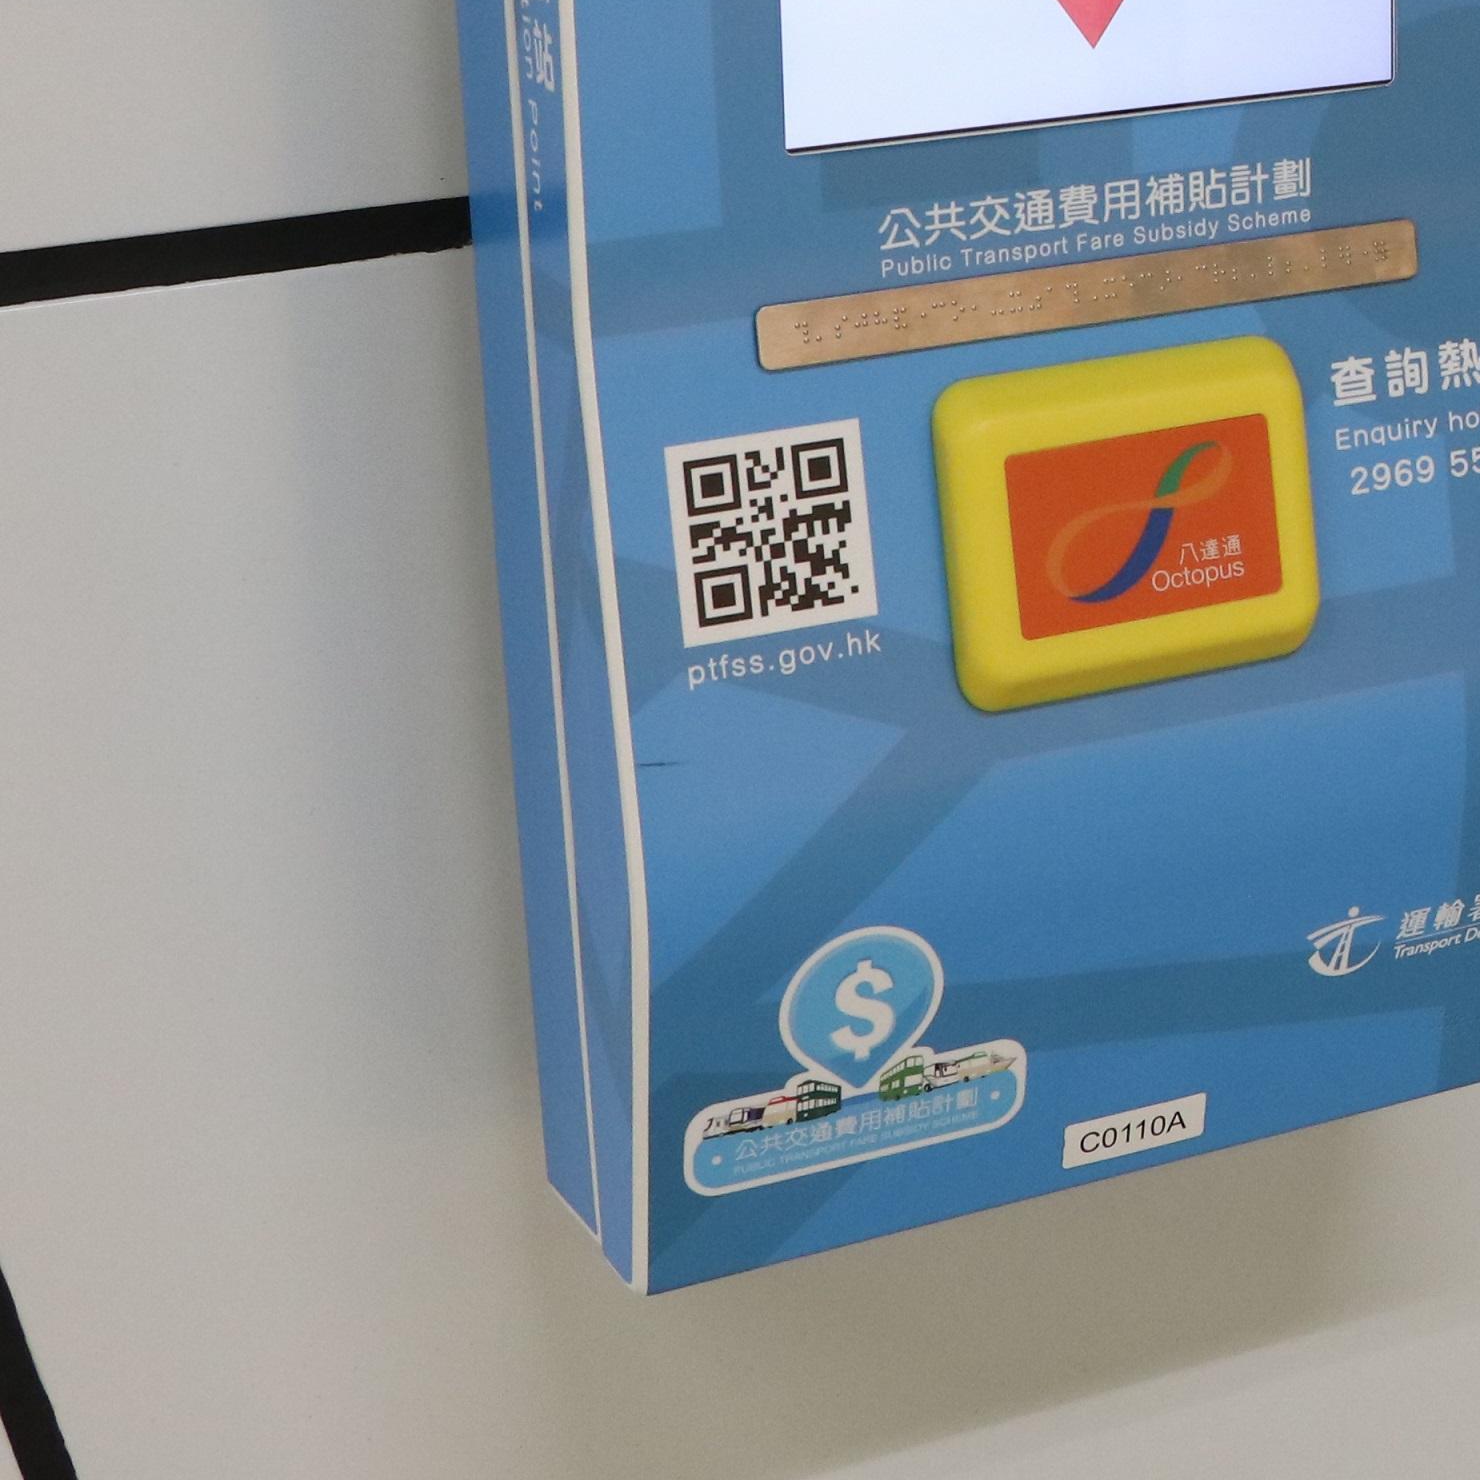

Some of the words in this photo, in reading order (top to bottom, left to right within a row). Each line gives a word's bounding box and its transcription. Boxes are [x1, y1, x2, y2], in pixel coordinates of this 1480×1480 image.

[878, 156, 1313, 253] 公共交通費用補貼計劃
[882, 254, 951, 278] Public
[961, 236, 1068, 267] Transport
[1077, 230, 1124, 252] Fare
[1133, 217, 1218, 247] Subsidy
[1227, 208, 1312, 231] Scheme
[1336, 417, 1437, 451] Enquiry
[1351, 455, 1434, 495] 2969
[1178, 534, 1243, 565] 八達通
[1151, 558, 1245, 593] Octopus
[687, 630, 881, 690] ptfss.gov.hk
[1393, 927, 1462, 962] Transport
[1078, 1109, 1188, 1156] C0110A
